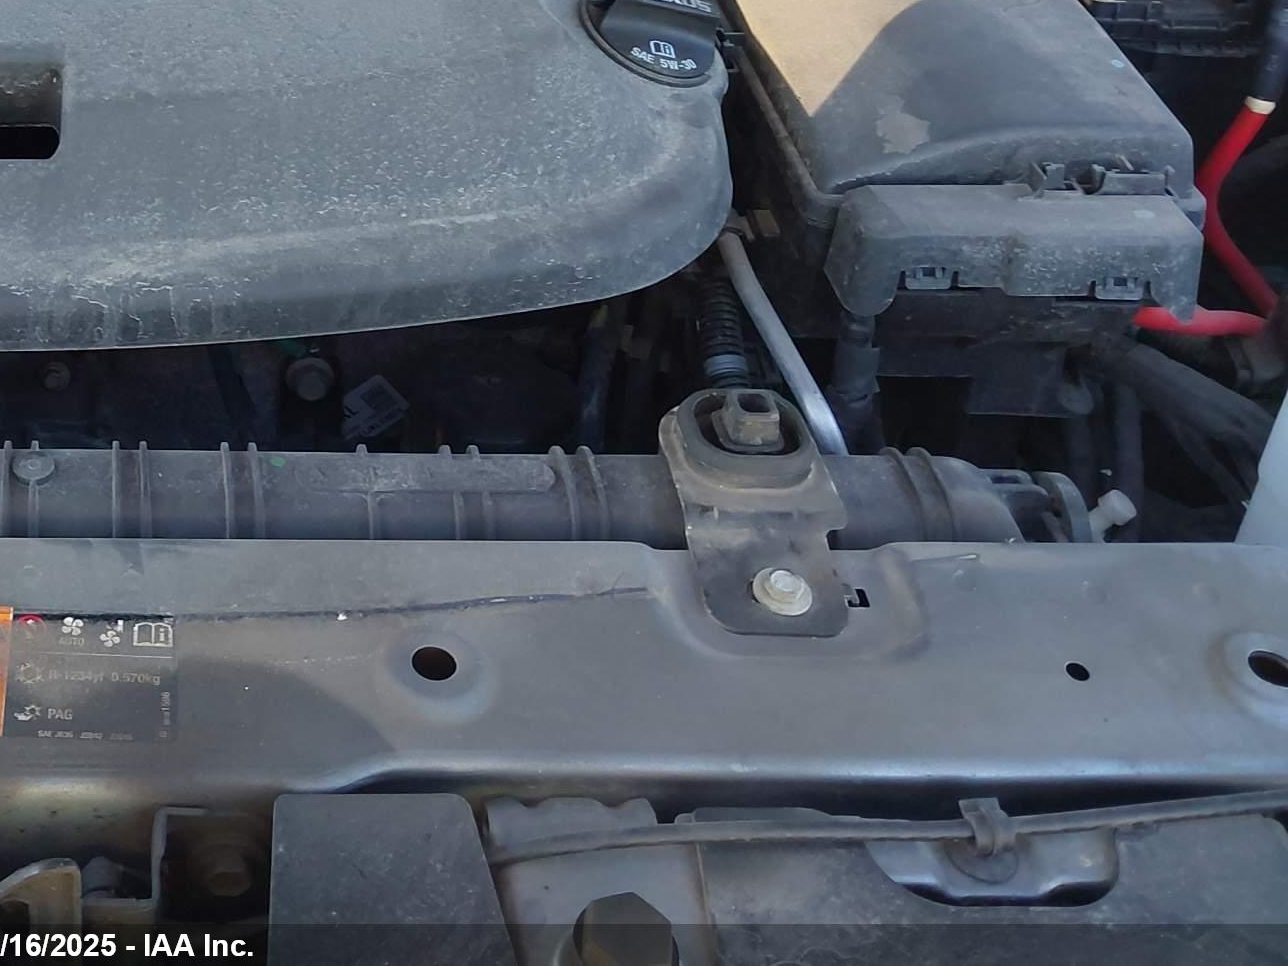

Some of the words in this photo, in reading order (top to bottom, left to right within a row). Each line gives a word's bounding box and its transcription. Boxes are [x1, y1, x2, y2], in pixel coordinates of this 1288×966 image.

[630, 46, 655, 64] SAE
[659, 58, 697, 70] 5W-30
[47, 708, 73, 720] PAG
